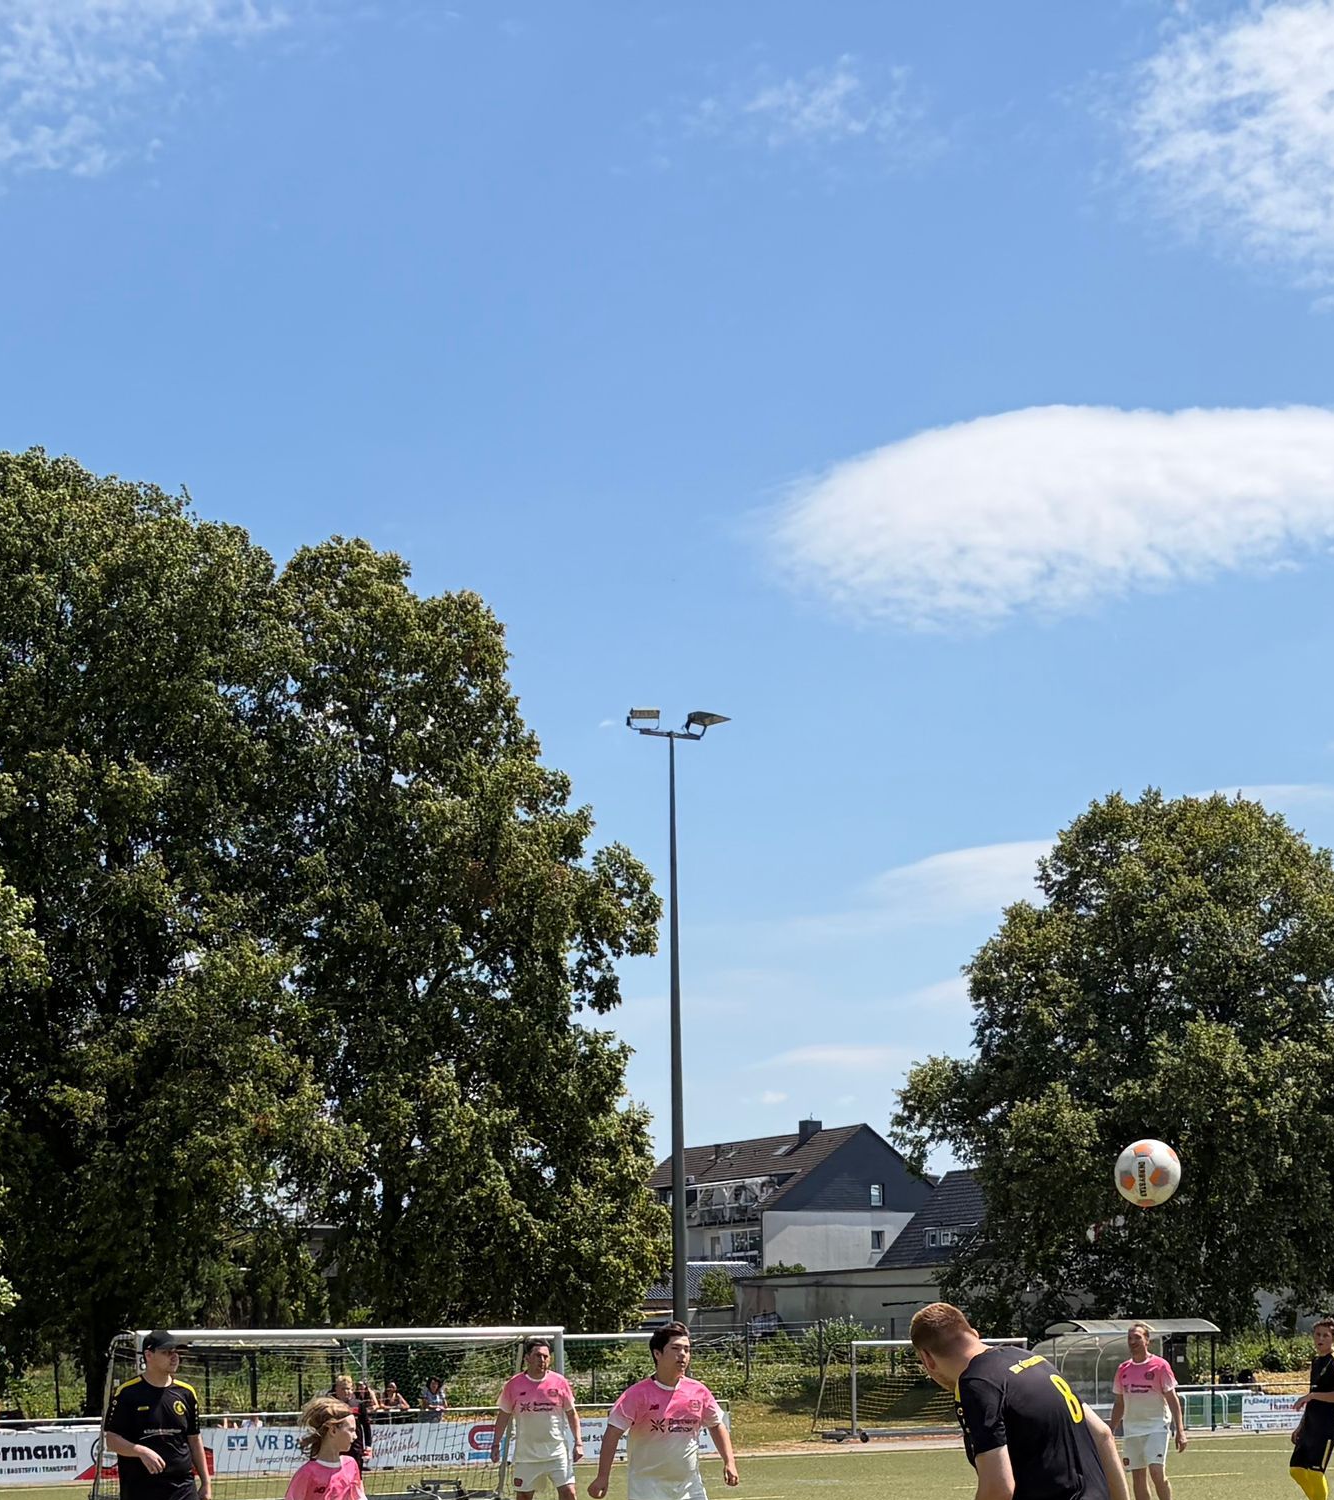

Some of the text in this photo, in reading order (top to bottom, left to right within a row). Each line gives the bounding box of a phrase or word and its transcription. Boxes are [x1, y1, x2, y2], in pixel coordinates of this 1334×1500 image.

[1050, 1374, 1083, 1424] 8
[255, 1434, 302, 1450] VR Ba
[403, 1451, 466, 1463] FACHBETRIEB FÜR
